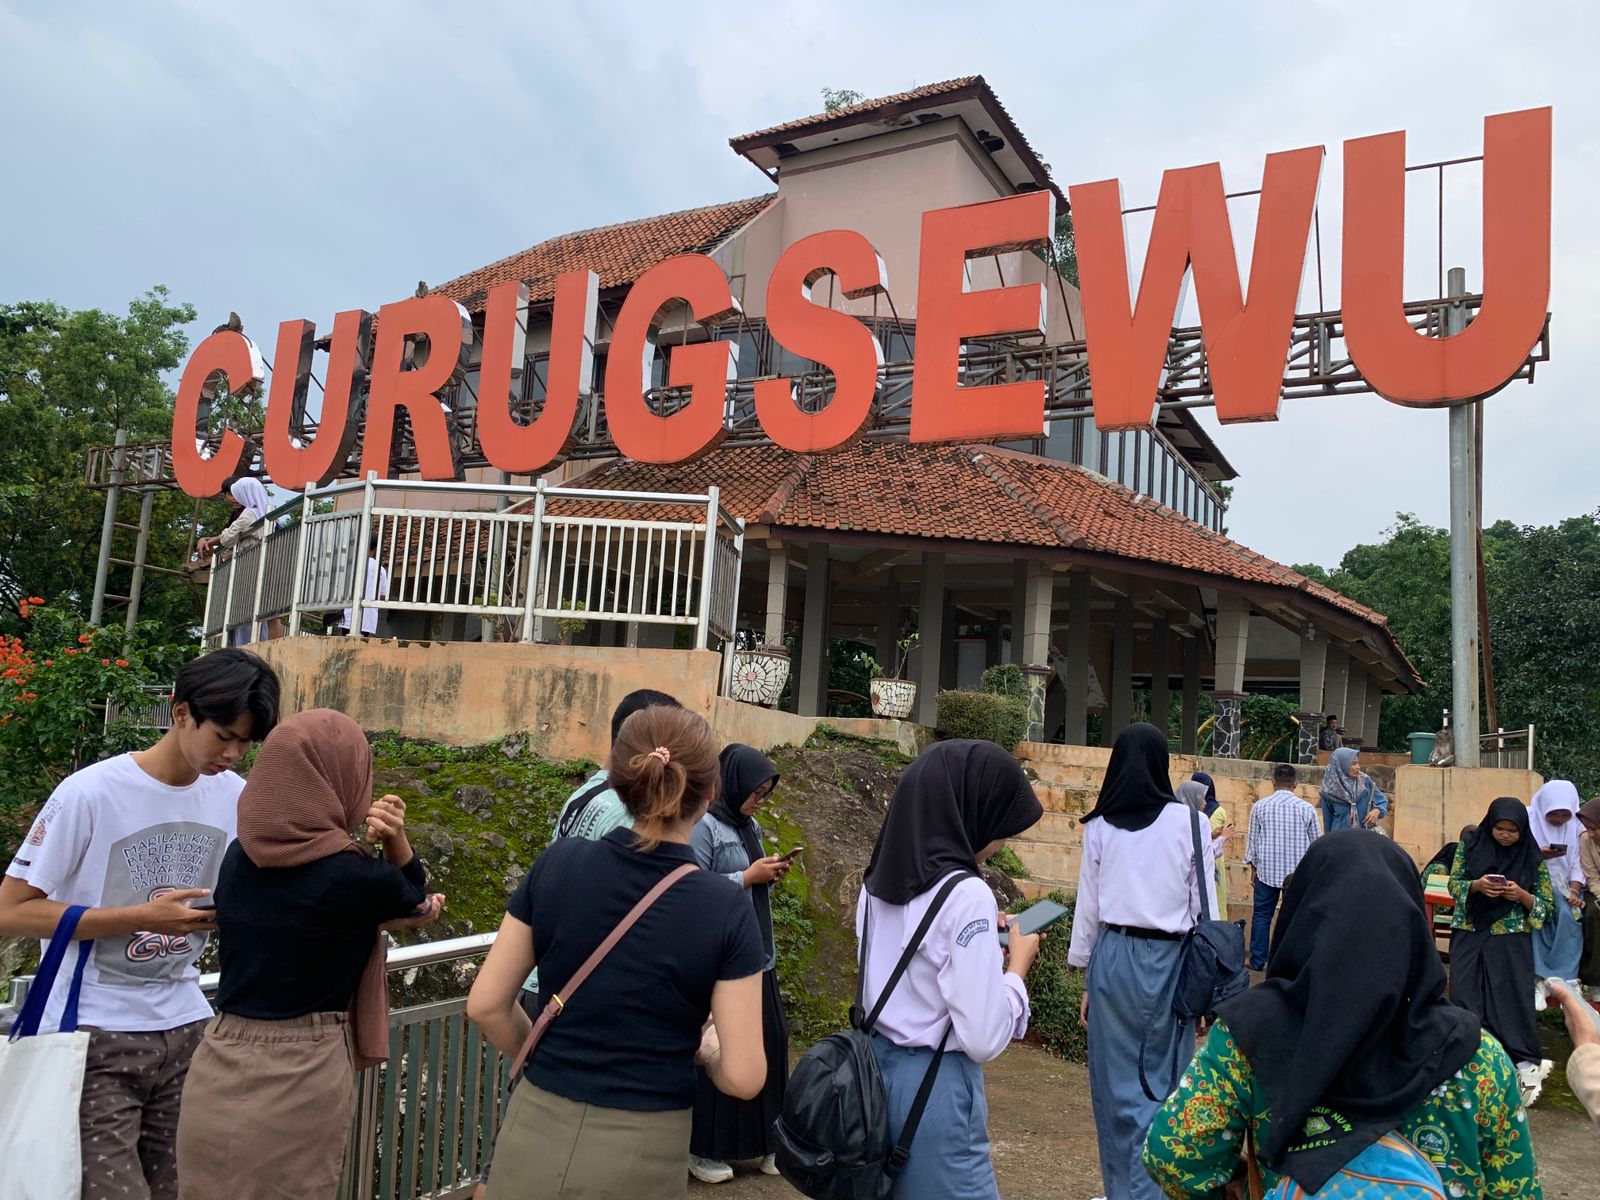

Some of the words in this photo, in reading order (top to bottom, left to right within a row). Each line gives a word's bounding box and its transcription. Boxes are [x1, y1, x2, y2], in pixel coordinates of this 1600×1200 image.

[171, 106, 1552, 498] CURUGSEWU
[122, 831, 188, 858] MARILAH
[191, 833, 216, 849] KITA
[127, 843, 210, 868] BERIBADAH
[130, 855, 177, 874] SECARA
[180, 854, 207, 869] BAIK
[132, 864, 175, 886] BENAR
[133, 874, 171, 893] TAHU
